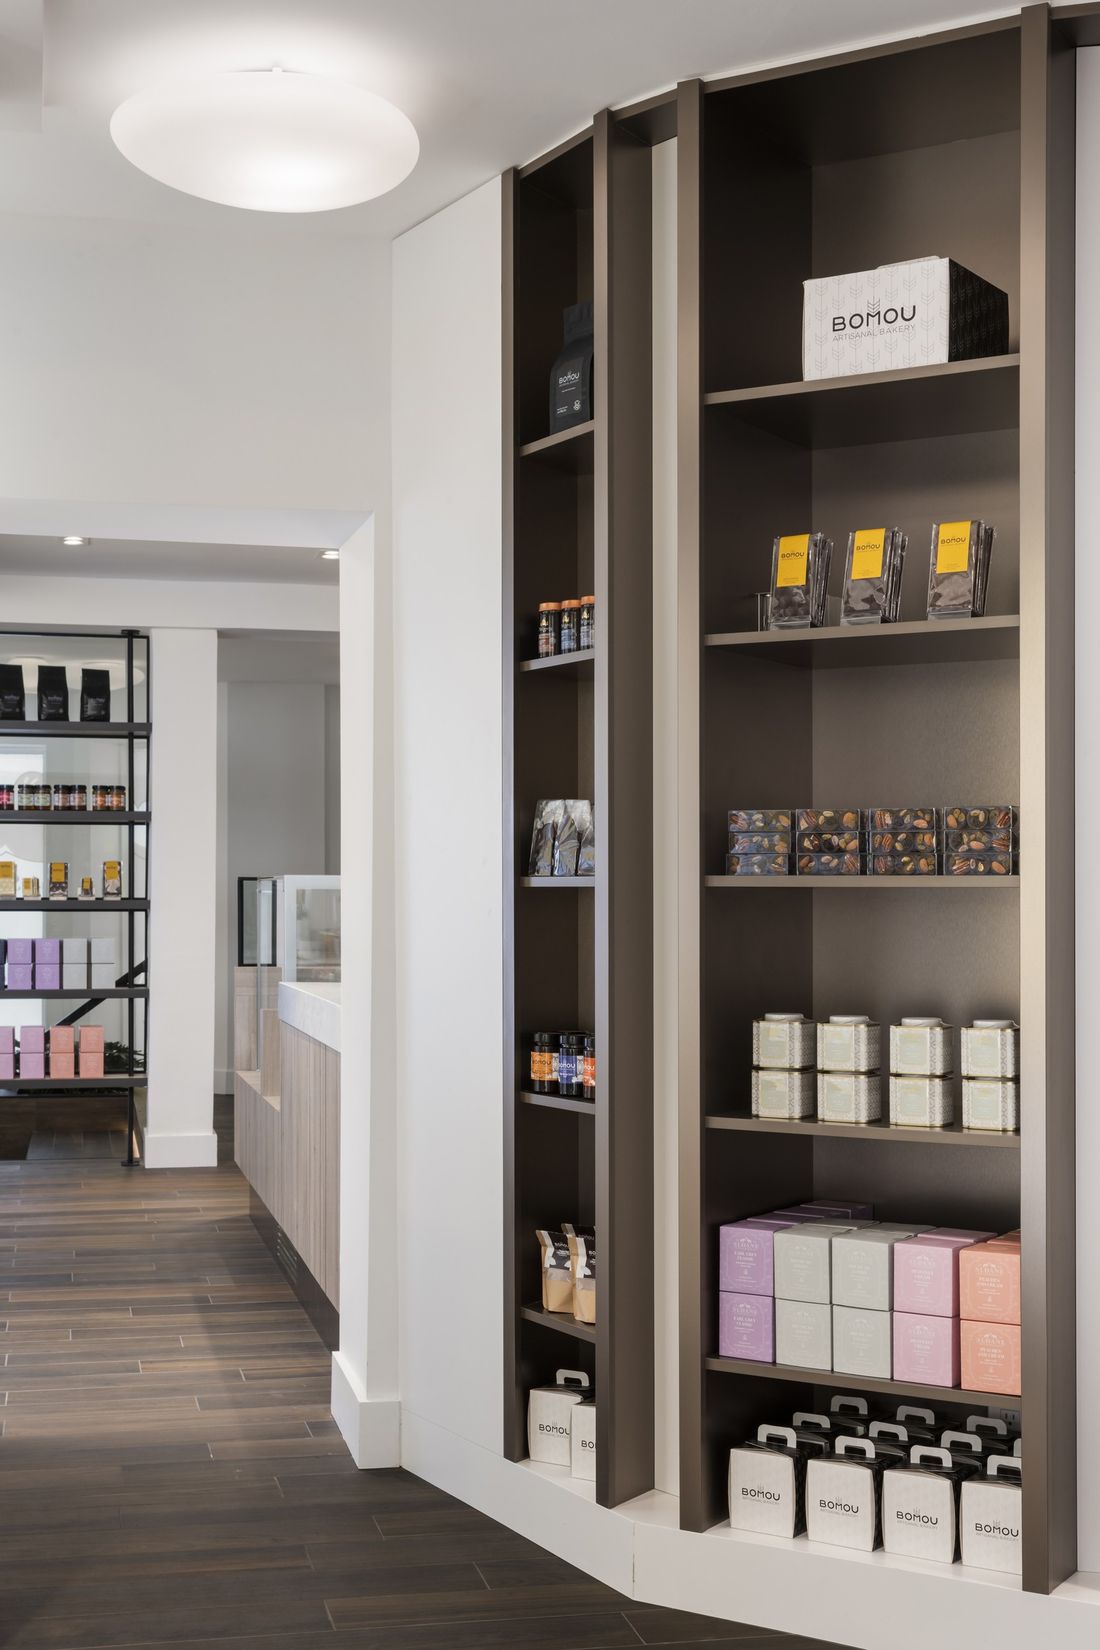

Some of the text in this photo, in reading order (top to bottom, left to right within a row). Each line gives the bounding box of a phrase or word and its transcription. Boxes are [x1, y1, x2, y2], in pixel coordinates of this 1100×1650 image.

[832, 305, 916, 332] BOMOU
[832, 324, 915, 342] ARTISANAL BAKERY
[856, 543, 881, 551] BOMOU
[781, 551, 805, 559] BOMOU
[741, 1487, 781, 1501] BOMOU
[819, 1499, 859, 1514] BOMOU
[896, 1510, 938, 1525] BOMOU
[975, 1522, 1019, 1538] BOMOU
